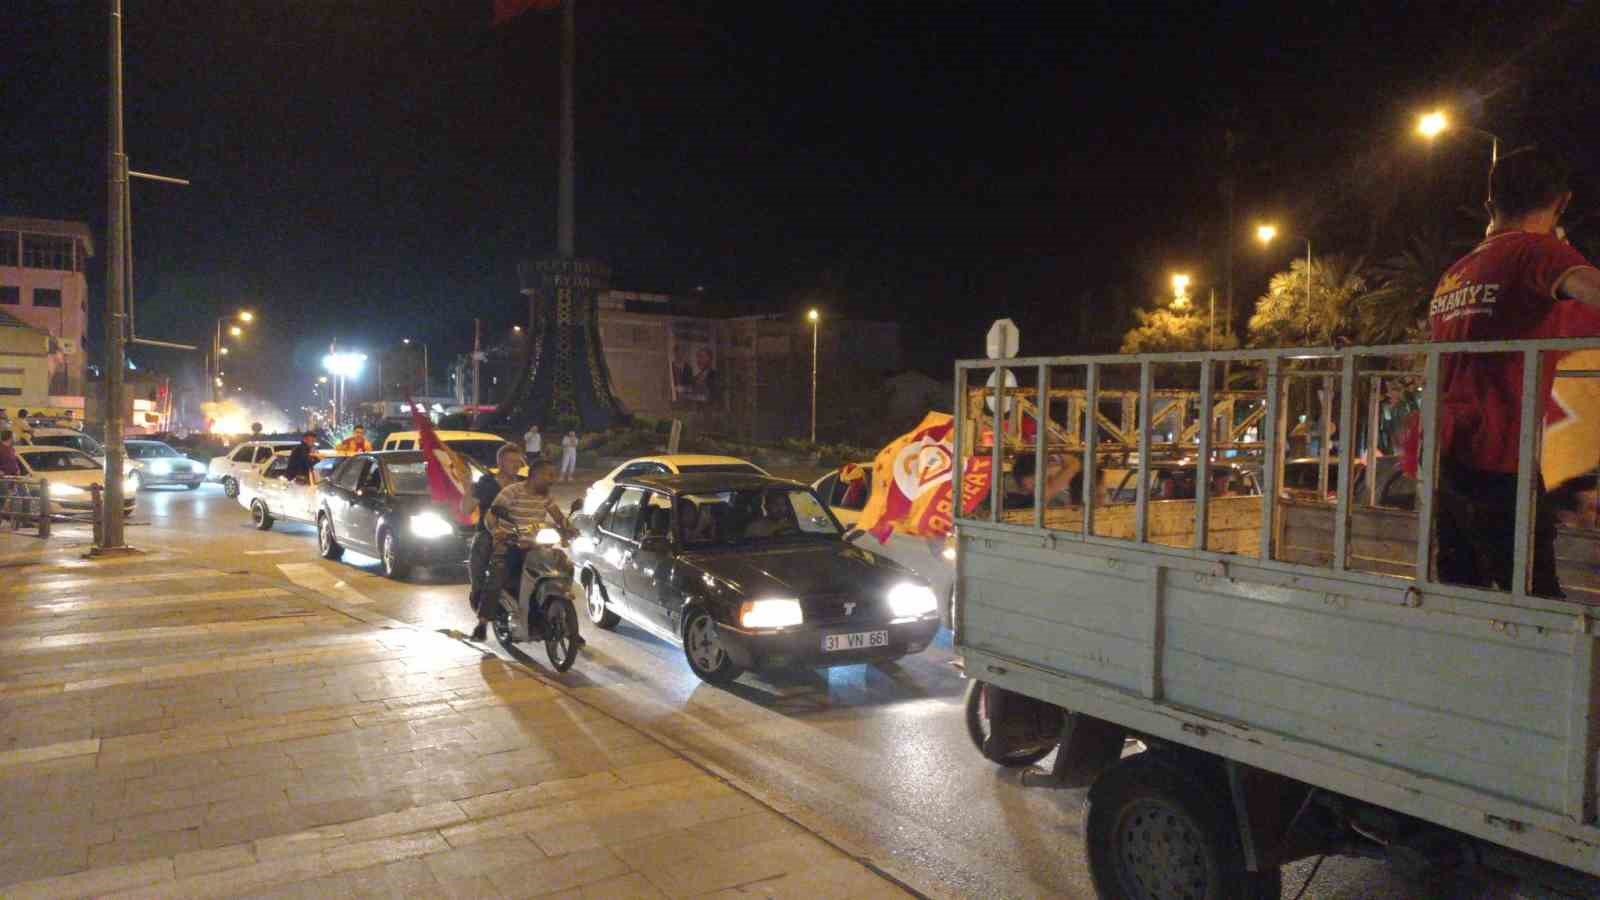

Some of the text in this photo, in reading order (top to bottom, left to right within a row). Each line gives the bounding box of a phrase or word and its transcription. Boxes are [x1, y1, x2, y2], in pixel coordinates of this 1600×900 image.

[827, 631, 888, 650] 31 VN 661
